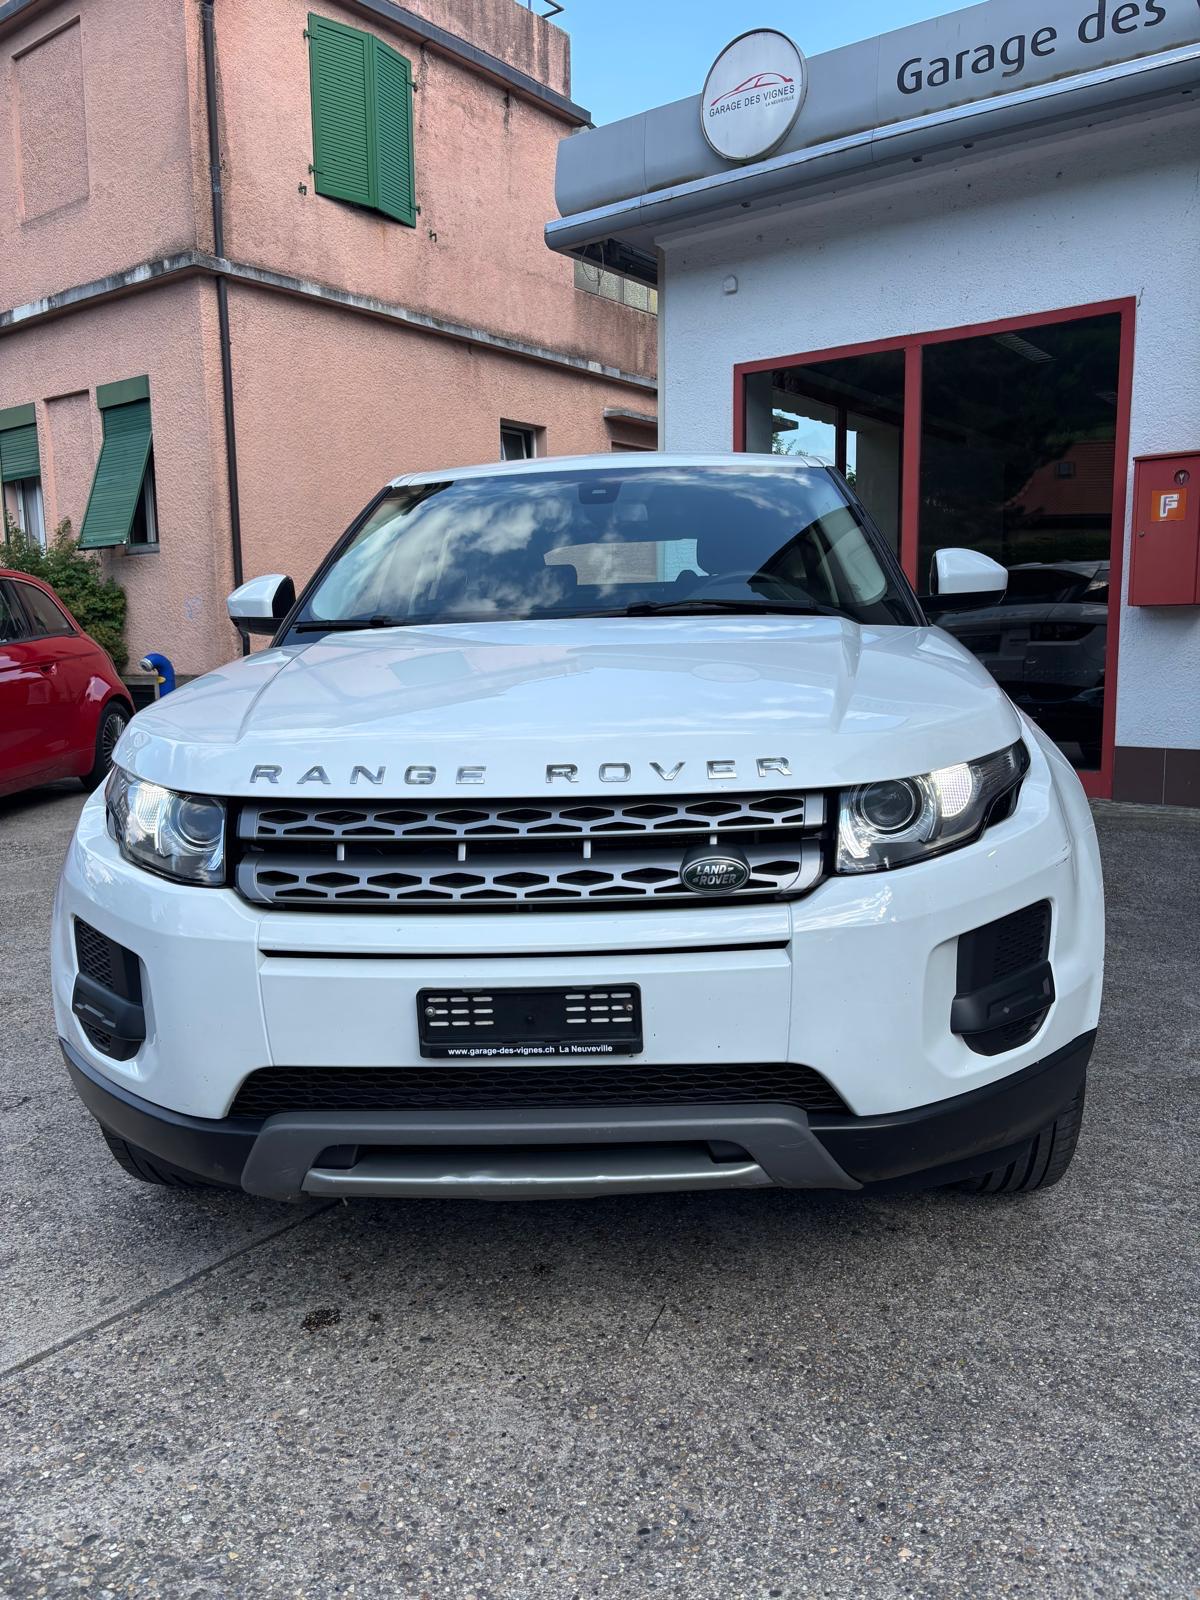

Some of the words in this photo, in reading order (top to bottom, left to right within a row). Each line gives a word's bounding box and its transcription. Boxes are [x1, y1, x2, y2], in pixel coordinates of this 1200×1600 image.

[896, 26, 1058, 95] Garage
[1077, 0, 1166, 44] des
[709, 101, 742, 117] GARAGE
[745, 94, 761, 107] DES
[763, 85, 795, 100] VIGNES
[1160, 494, 1180, 518] F
[249, 763, 487, 785] RANGE
[545, 756, 793, 785] ROVER
[696, 864, 727, 875] LAND
[699, 873, 737, 885] ROVER
[447, 1046, 555, 1056] www.garage-des-vignes.ch
[571, 1044, 613, 1053] Neuveville
